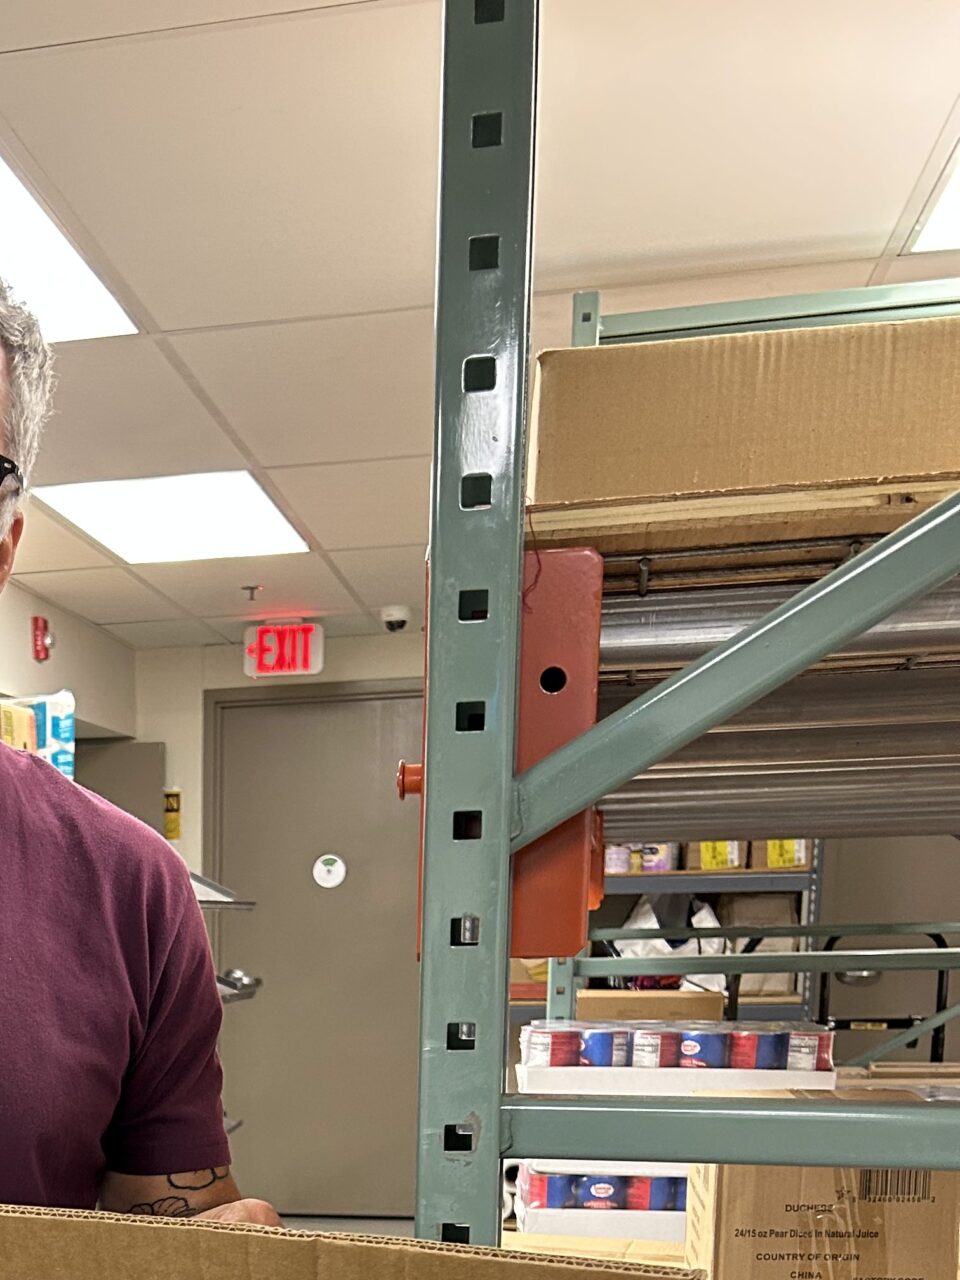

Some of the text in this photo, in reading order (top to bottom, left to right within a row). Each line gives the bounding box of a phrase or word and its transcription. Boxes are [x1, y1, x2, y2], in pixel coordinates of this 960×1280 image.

[256, 623, 316, 673] EXIT
[734, 1229, 756, 1238] 24/15
[769, 1229, 787, 1238] Pear
[856, 1229, 879, 1239] Juice
[756, 1253, 805, 1261] COUNTRY
[807, 1253, 821, 1261] OF
[790, 1271, 822, 1279] CHINA
